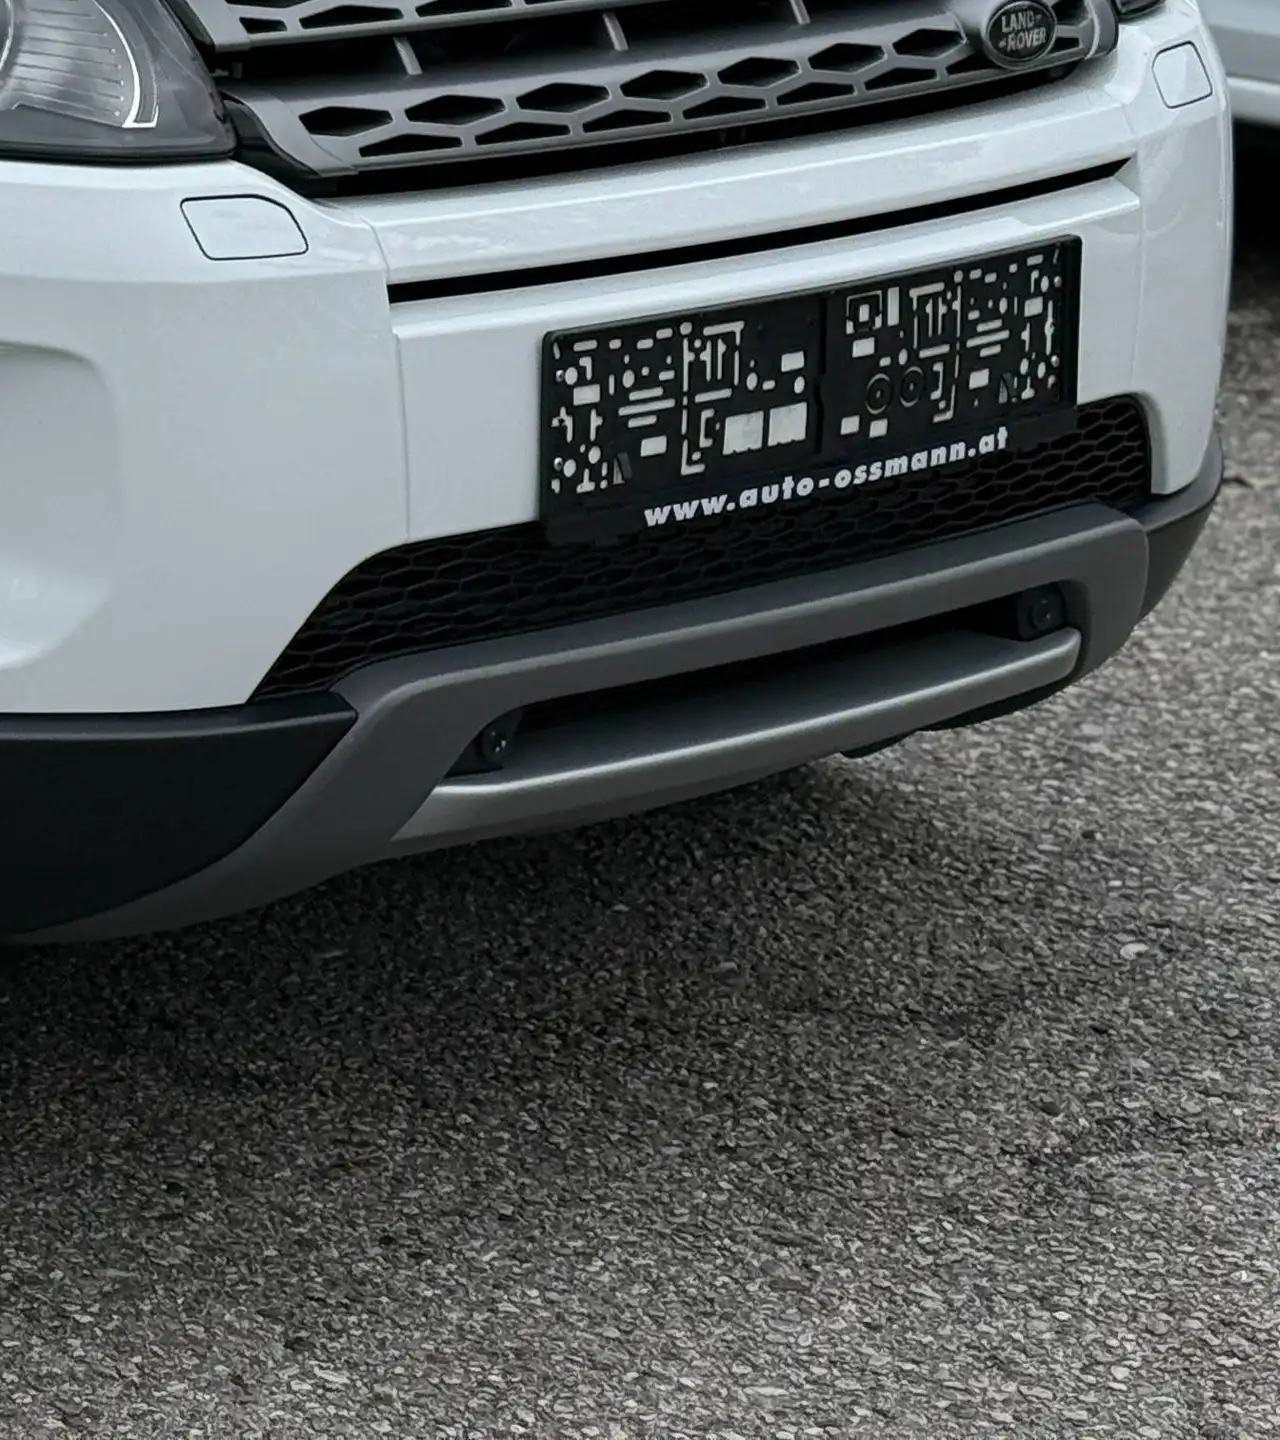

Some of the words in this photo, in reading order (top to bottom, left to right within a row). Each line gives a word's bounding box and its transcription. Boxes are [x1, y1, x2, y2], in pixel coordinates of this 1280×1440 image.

[1001, 10, 1035, 33] LAND
[1007, 27, 1047, 53] ROVER
[643, 426, 1010, 527] www.auto-ossmann.at
